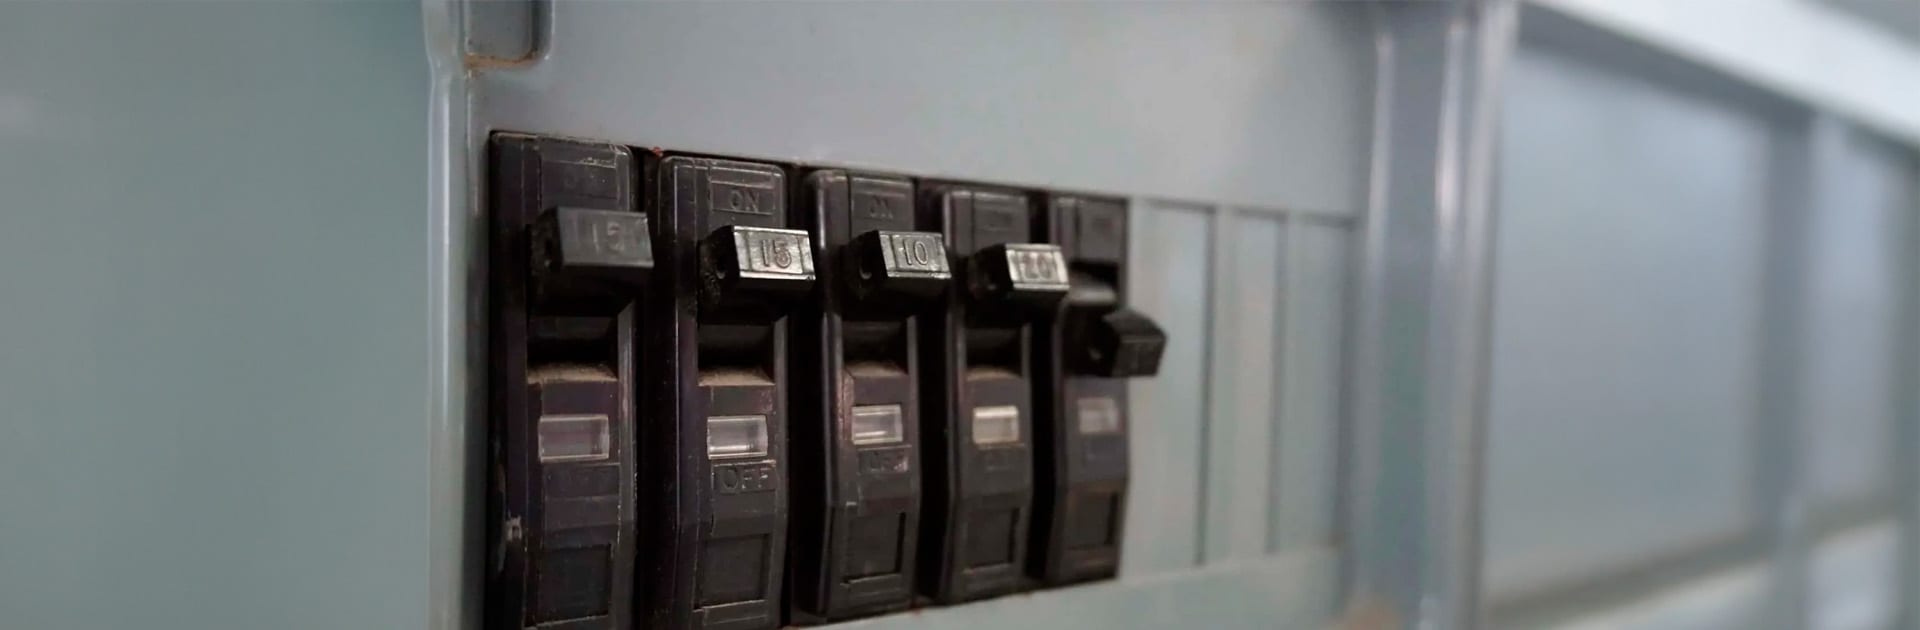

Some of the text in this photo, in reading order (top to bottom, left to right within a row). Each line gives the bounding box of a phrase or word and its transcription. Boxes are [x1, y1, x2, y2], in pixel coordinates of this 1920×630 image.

[729, 189, 761, 212] ON
[760, 238, 792, 269] 15
[901, 238, 929, 267] 10
[722, 465, 770, 489] OFF
